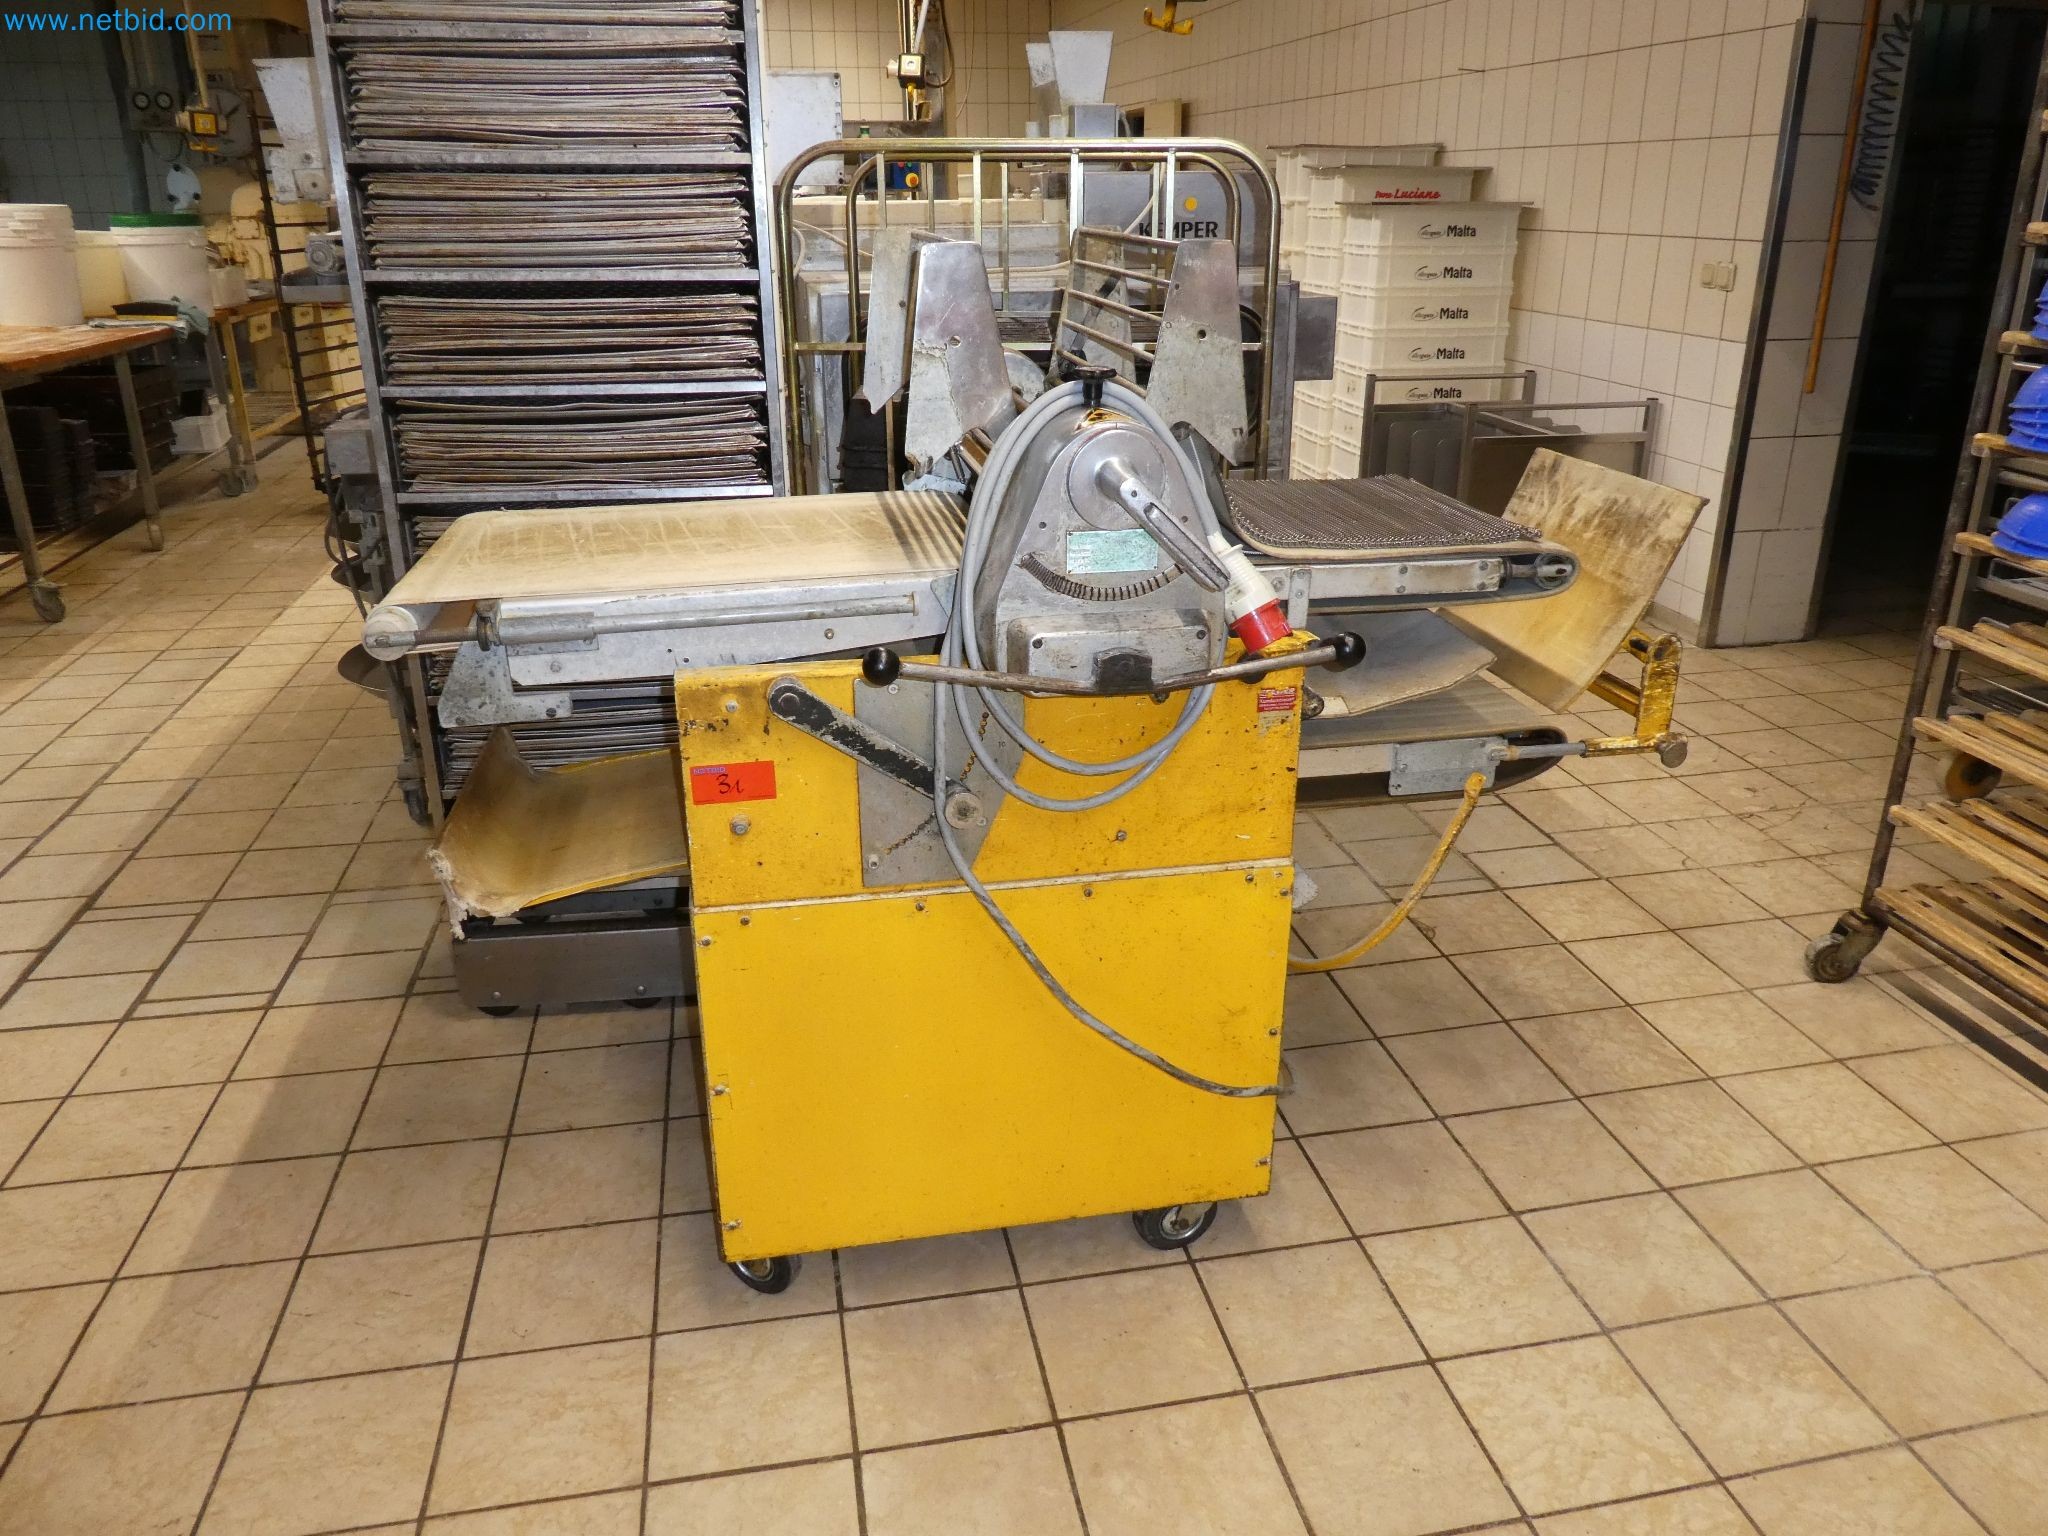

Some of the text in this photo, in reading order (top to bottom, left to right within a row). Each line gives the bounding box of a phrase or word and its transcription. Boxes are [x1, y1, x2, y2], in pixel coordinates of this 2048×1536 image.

[1446, 224, 1477, 238] Malta
[1442, 266, 1473, 279] Malta
[1439, 307, 1469, 320] Malta
[1436, 347, 1465, 360] Malta
[1433, 386, 1462, 399] Malta
